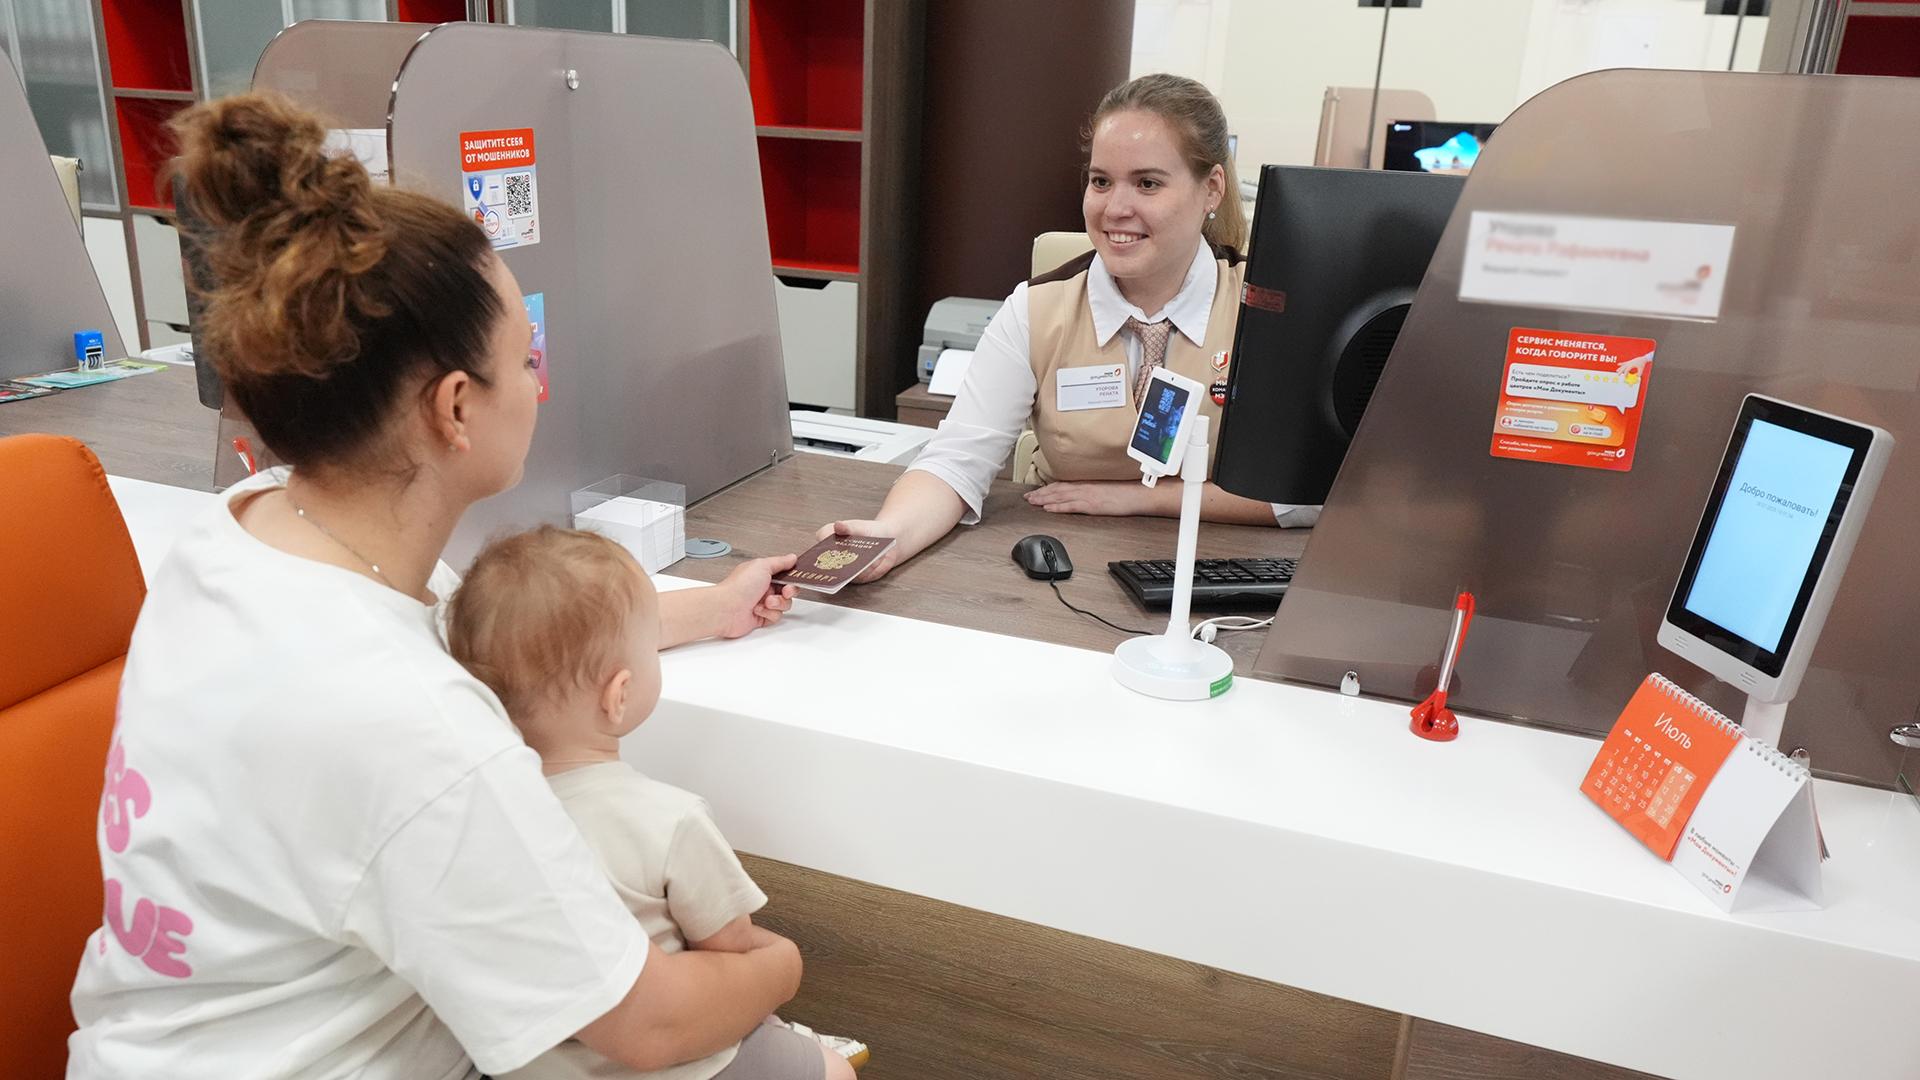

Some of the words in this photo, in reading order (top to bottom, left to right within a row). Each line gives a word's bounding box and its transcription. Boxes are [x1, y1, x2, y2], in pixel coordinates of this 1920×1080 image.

[464, 138, 506, 150] ЗАЩИТИТЕ
[506, 137, 523, 147] СЕБЯ
[465, 154, 476, 164] ОТ
[477, 149, 530, 162] МОШЕННИКОВ
[1517, 336, 1553, 345] СЕРВИС
[1554, 339, 1607, 352] МЕНЯЕТСЯ,
[1515, 347, 1547, 356] КОГДА
[1548, 350, 1598, 361] ГОВОРИТЕ
[1600, 355, 1617, 363] ВЫ!
[1739, 481, 1766, 498] Добро
[1766, 493, 1819, 518] пожаловать!
[1654, 712, 1691, 749] Июль
[1648, 760, 1654, 768] 3
[1607, 759, 1613, 767] 14
[1616, 766, 1624, 775] 15
[1626, 774, 1632, 782] 16
[1635, 781, 1643, 789] 17
[1642, 770, 1649, 779] 10
[1651, 778, 1658, 786] 11
[1601, 769, 1608, 777] 21
[1609, 776, 1618, 786] 22
[1618, 784, 1627, 793] 23
[1628, 791, 1636, 800] 24
[1638, 799, 1647, 809] 25
